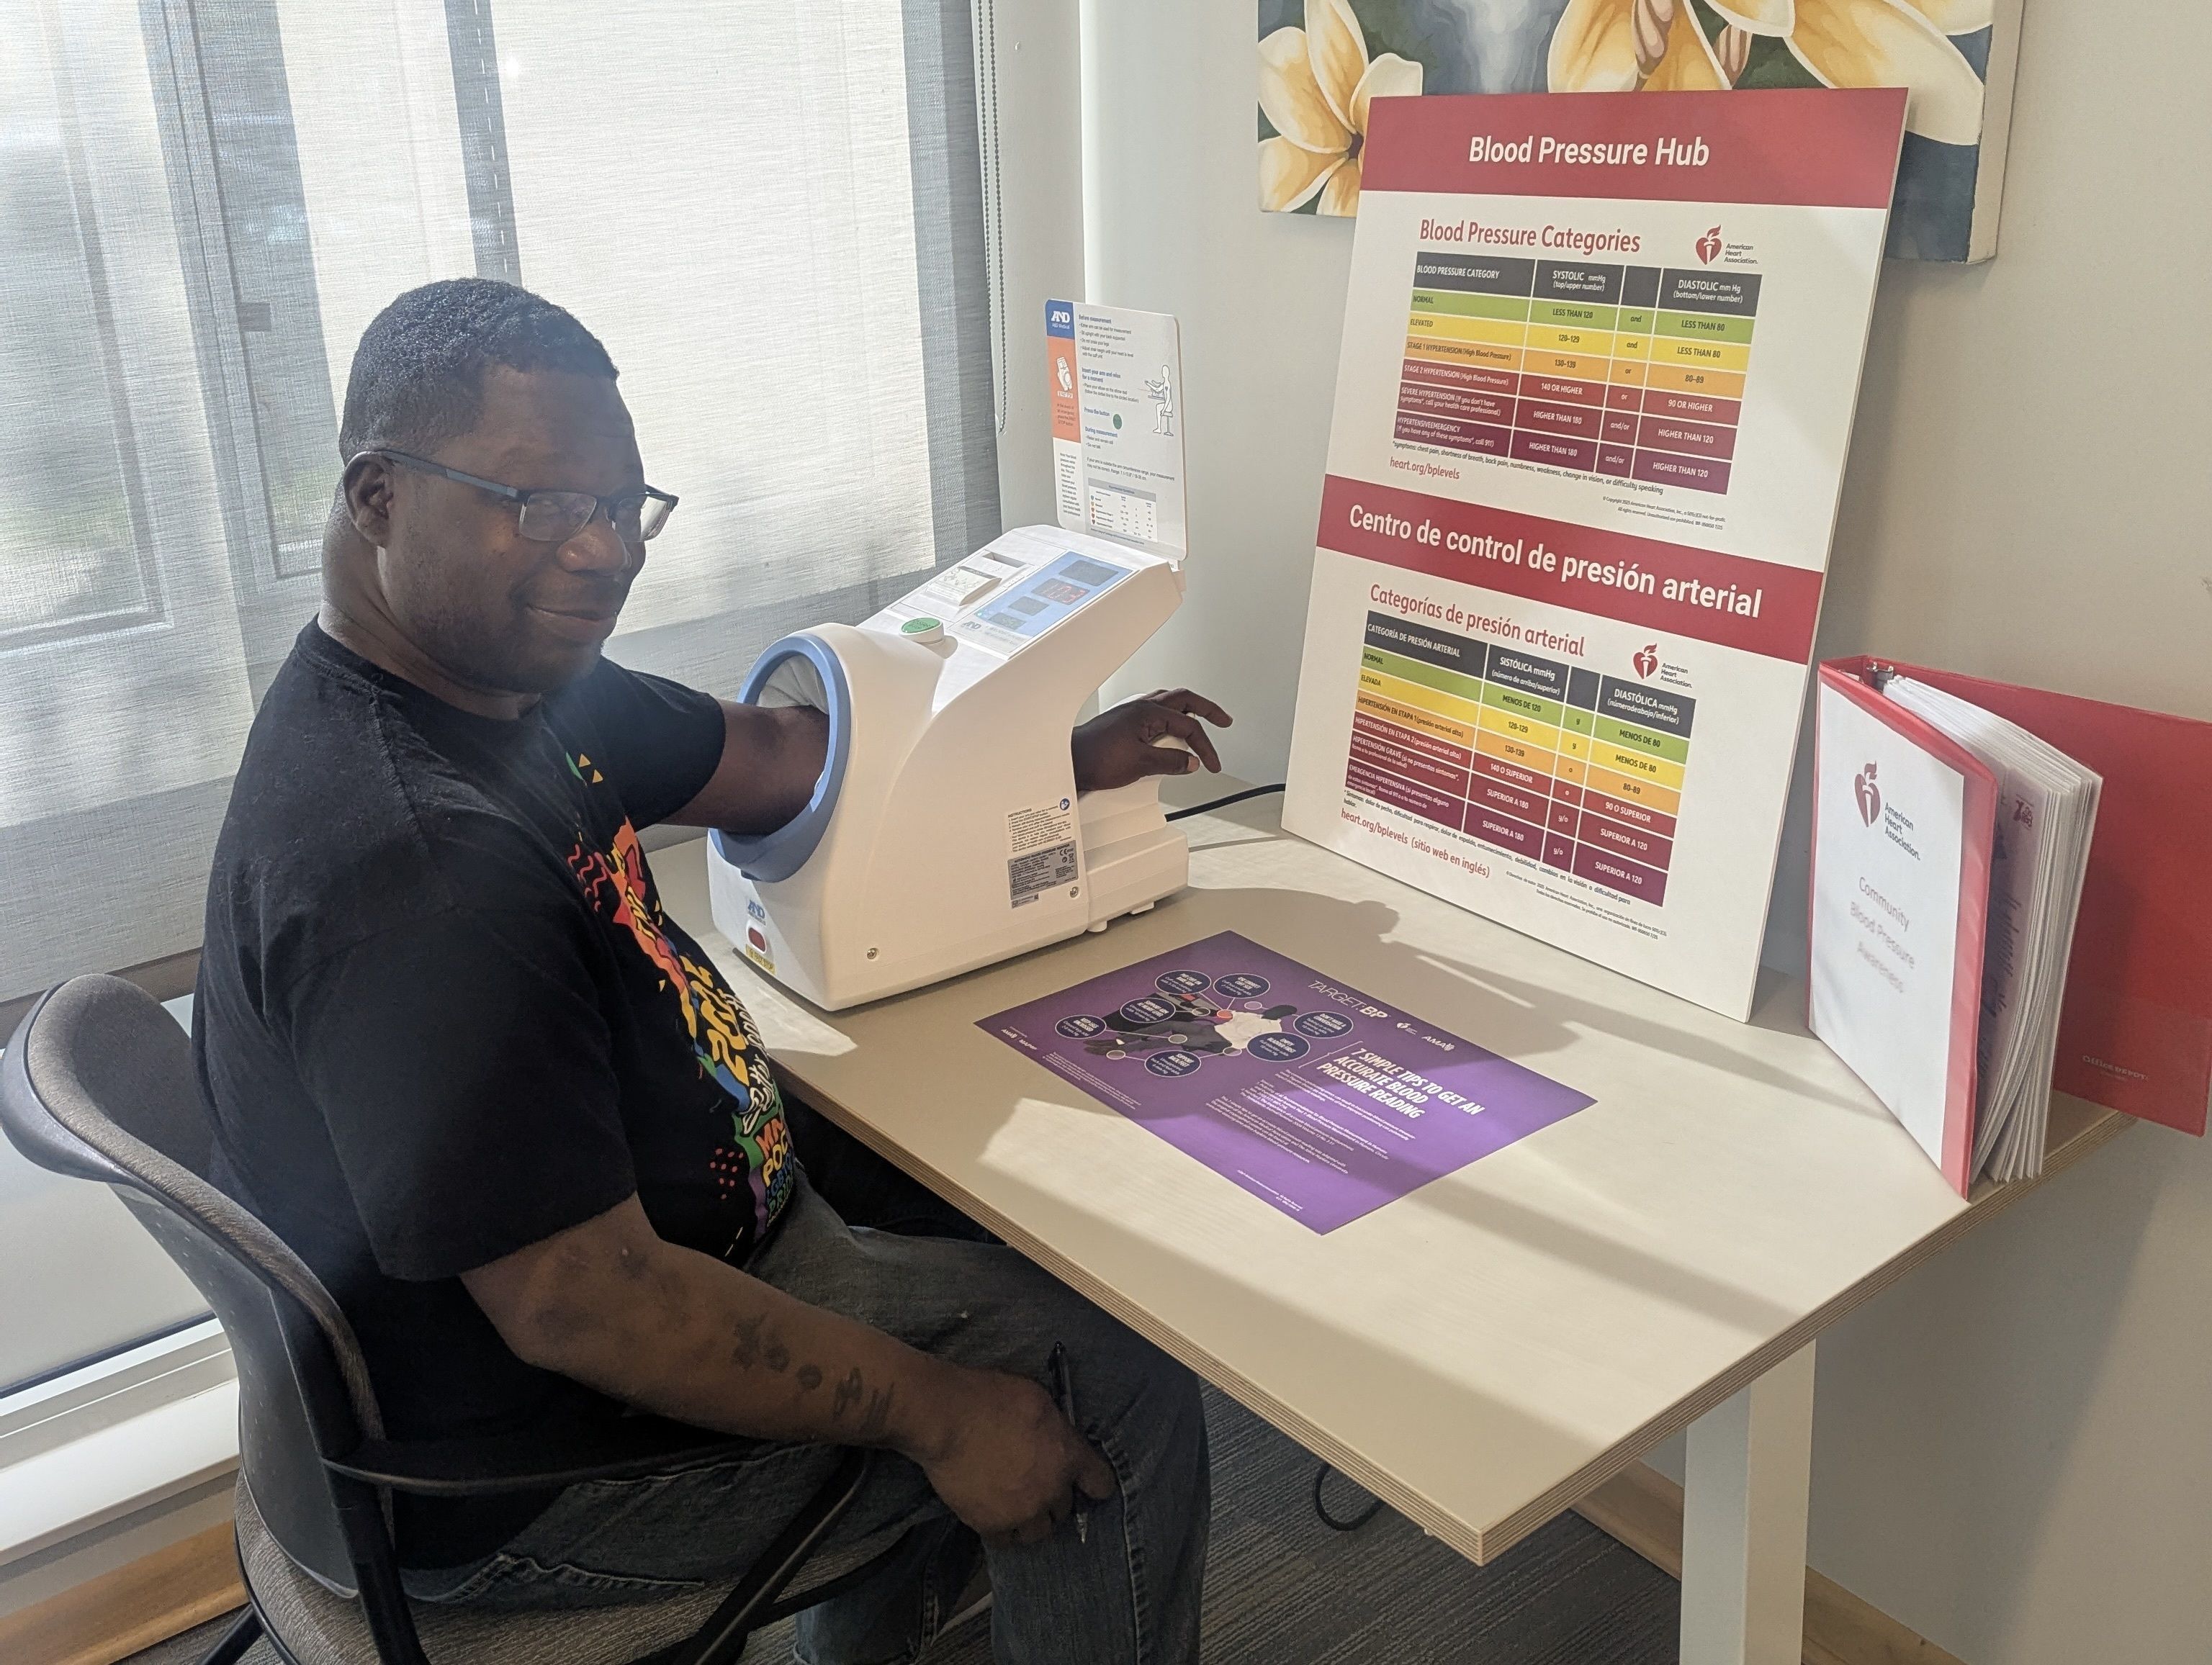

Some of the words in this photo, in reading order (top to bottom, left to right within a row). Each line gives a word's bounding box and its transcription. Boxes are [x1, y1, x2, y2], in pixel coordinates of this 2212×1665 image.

[1469, 135, 1534, 163] Blood
[1538, 137, 1648, 165] Pressure
[1655, 136, 1709, 166] Hub
[1420, 218, 1465, 242] Blood
[1467, 222, 1537, 246] Pressure
[1542, 225, 1641, 256] Categories
[1725, 243, 1753, 251] American
[1416, 265, 1437, 274] BLOOD
[1437, 266, 1467, 276] PRESSURE
[1467, 269, 1500, 279] CATEGORY
[1552, 270, 1585, 281] SYSTOLIC
[1678, 279, 1719, 292] DIASTOLIC
[1413, 295, 1434, 304] NORMAL
[1552, 308, 1566, 317] LESS
[1565, 309, 1583, 317] THAN
[1581, 310, 1593, 319] 120
[1410, 318, 1434, 328] ELEVATED
[1681, 320, 1696, 329] LESS
[1697, 321, 1717, 330] THAN
[1717, 322, 1725, 331] 80
[1407, 341, 1422, 350] STAGE
[1426, 344, 1462, 355] HYPERTENSION
[1677, 346, 1693, 356] LESS
[1694, 348, 1712, 357] THAN
[1712, 350, 1721, 358] 80
[1404, 364, 1419, 374] STAGE
[1423, 367, 1460, 379] HYPERTENSION
[1541, 382, 1551, 391] 140
[1551, 384, 1560, 392] OR
[1560, 385, 1583, 395] HIGHER
[1668, 399, 1676, 407] 90
[1677, 400, 1687, 409] OR
[1687, 402, 1713, 412] HIGHER
[1533, 410, 1555, 420] HIGHER
[1555, 413, 1572, 423] THAN
[1573, 416, 1582, 425] 180
[1610, 422, 1630, 430] and/or
[1658, 428, 1683, 439] HIGHER
[1683, 432, 1702, 442] THAN
[1703, 435, 1714, 444] 120
[1529, 442, 1550, 452] HIGHER
[1551, 445, 1568, 455] THAN
[1568, 448, 1578, 456] 180
[1389, 456, 1460, 479] heart.org/bplevels
[1605, 455, 1625, 464] and/or
[1653, 461, 1677, 473] HIGHER
[1678, 466, 1696, 476] THAN
[1697, 469, 1709, 478] 120
[1349, 505, 1411, 539] Centro
[1416, 519, 1441, 546] de
[1447, 531, 1523, 565] control
[1528, 543, 1556, 572] de
[1561, 556, 1655, 595] presión
[1662, 578, 1762, 618] arterial
[1370, 584, 1443, 619] Categorías
[1445, 603, 1463, 624] de
[1465, 613, 1521, 640] presión
[1524, 628, 1585, 657] arterial
[1367, 623, 1398, 639] CATEGORÍA
[1399, 632, 1407, 642] DE
[1407, 635, 1432, 649] PRESIÓN
[1432, 642, 1460, 657] ARTERIAL
[1364, 652, 1384, 664] NORMAL
[1499, 656, 1532, 673] SISTÓLICA
[1533, 668, 1555, 682] mmHg
[1660, 668, 1677, 678] Heart
[1662, 662, 1689, 674] American
[1361, 674, 1381, 686] ELEVADA
[1502, 695, 1523, 707] MENOS
[1523, 700, 1532, 710] DE
[1531, 703, 1541, 713] 120
[1614, 688, 1658, 708] DIASTÓLICA
[1658, 703, 1678, 716] mmHg
[1619, 728, 1642, 742] MENOS
[1642, 736, 1653, 745] DE
[1653, 739, 1660, 748] 80
[1615, 754, 1638, 767] MENOS
[1639, 761, 1648, 770] DE
[1648, 764, 1657, 773] 80
[1486, 788, 1514, 804] SUPERIOR
[1519, 800, 1529, 809] 180
[1605, 801, 1614, 811] 90
[1620, 806, 1651, 823] SUPERIOR
[1884, 802, 1914, 831] American
[1482, 820, 1509, 836] SUPERIOR
[1514, 832, 1524, 841] 180
[1884, 813, 1902, 834] Heart
[1341, 807, 1408, 844] heart.org/bplevels
[1411, 836, 1431, 854] (sitio
[1432, 847, 1449, 861] web
[1449, 855, 1460, 865] en
[1461, 857, 1490, 878] inglés)
[1600, 828, 1631, 845] SUPERIOR
[1630, 838, 1637, 847] A
[1637, 841, 1647, 851] 120
[1595, 861, 1625, 879] SUPERIOR
[1625, 872, 1631, 881] A
[1632, 875, 1642, 885] 120
[1859, 877, 1910, 932] Community
[1850, 901, 1876, 933] Blood
[1877, 924, 1915, 969] Pressure
[1422, 1036, 1444, 1048] AMA
[1333, 1056, 1394, 1086] ACCURATE
[1385, 1081, 1429, 1104] BLOOD
[1351, 1047, 1364, 1057] 7
[1358, 1052, 1404, 1075] SIMPLE
[1396, 1070, 1429, 1087] TIPS
[1421, 1082, 1443, 1094] TO
[1437, 1091, 1467, 1106] GET
[1457, 1102, 1485, 1115] AN
[1316, 1062, 1377, 1094] PRESSURE
[1368, 1088, 1426, 1119] READING
[763, 1128, 788, 1188] POC
